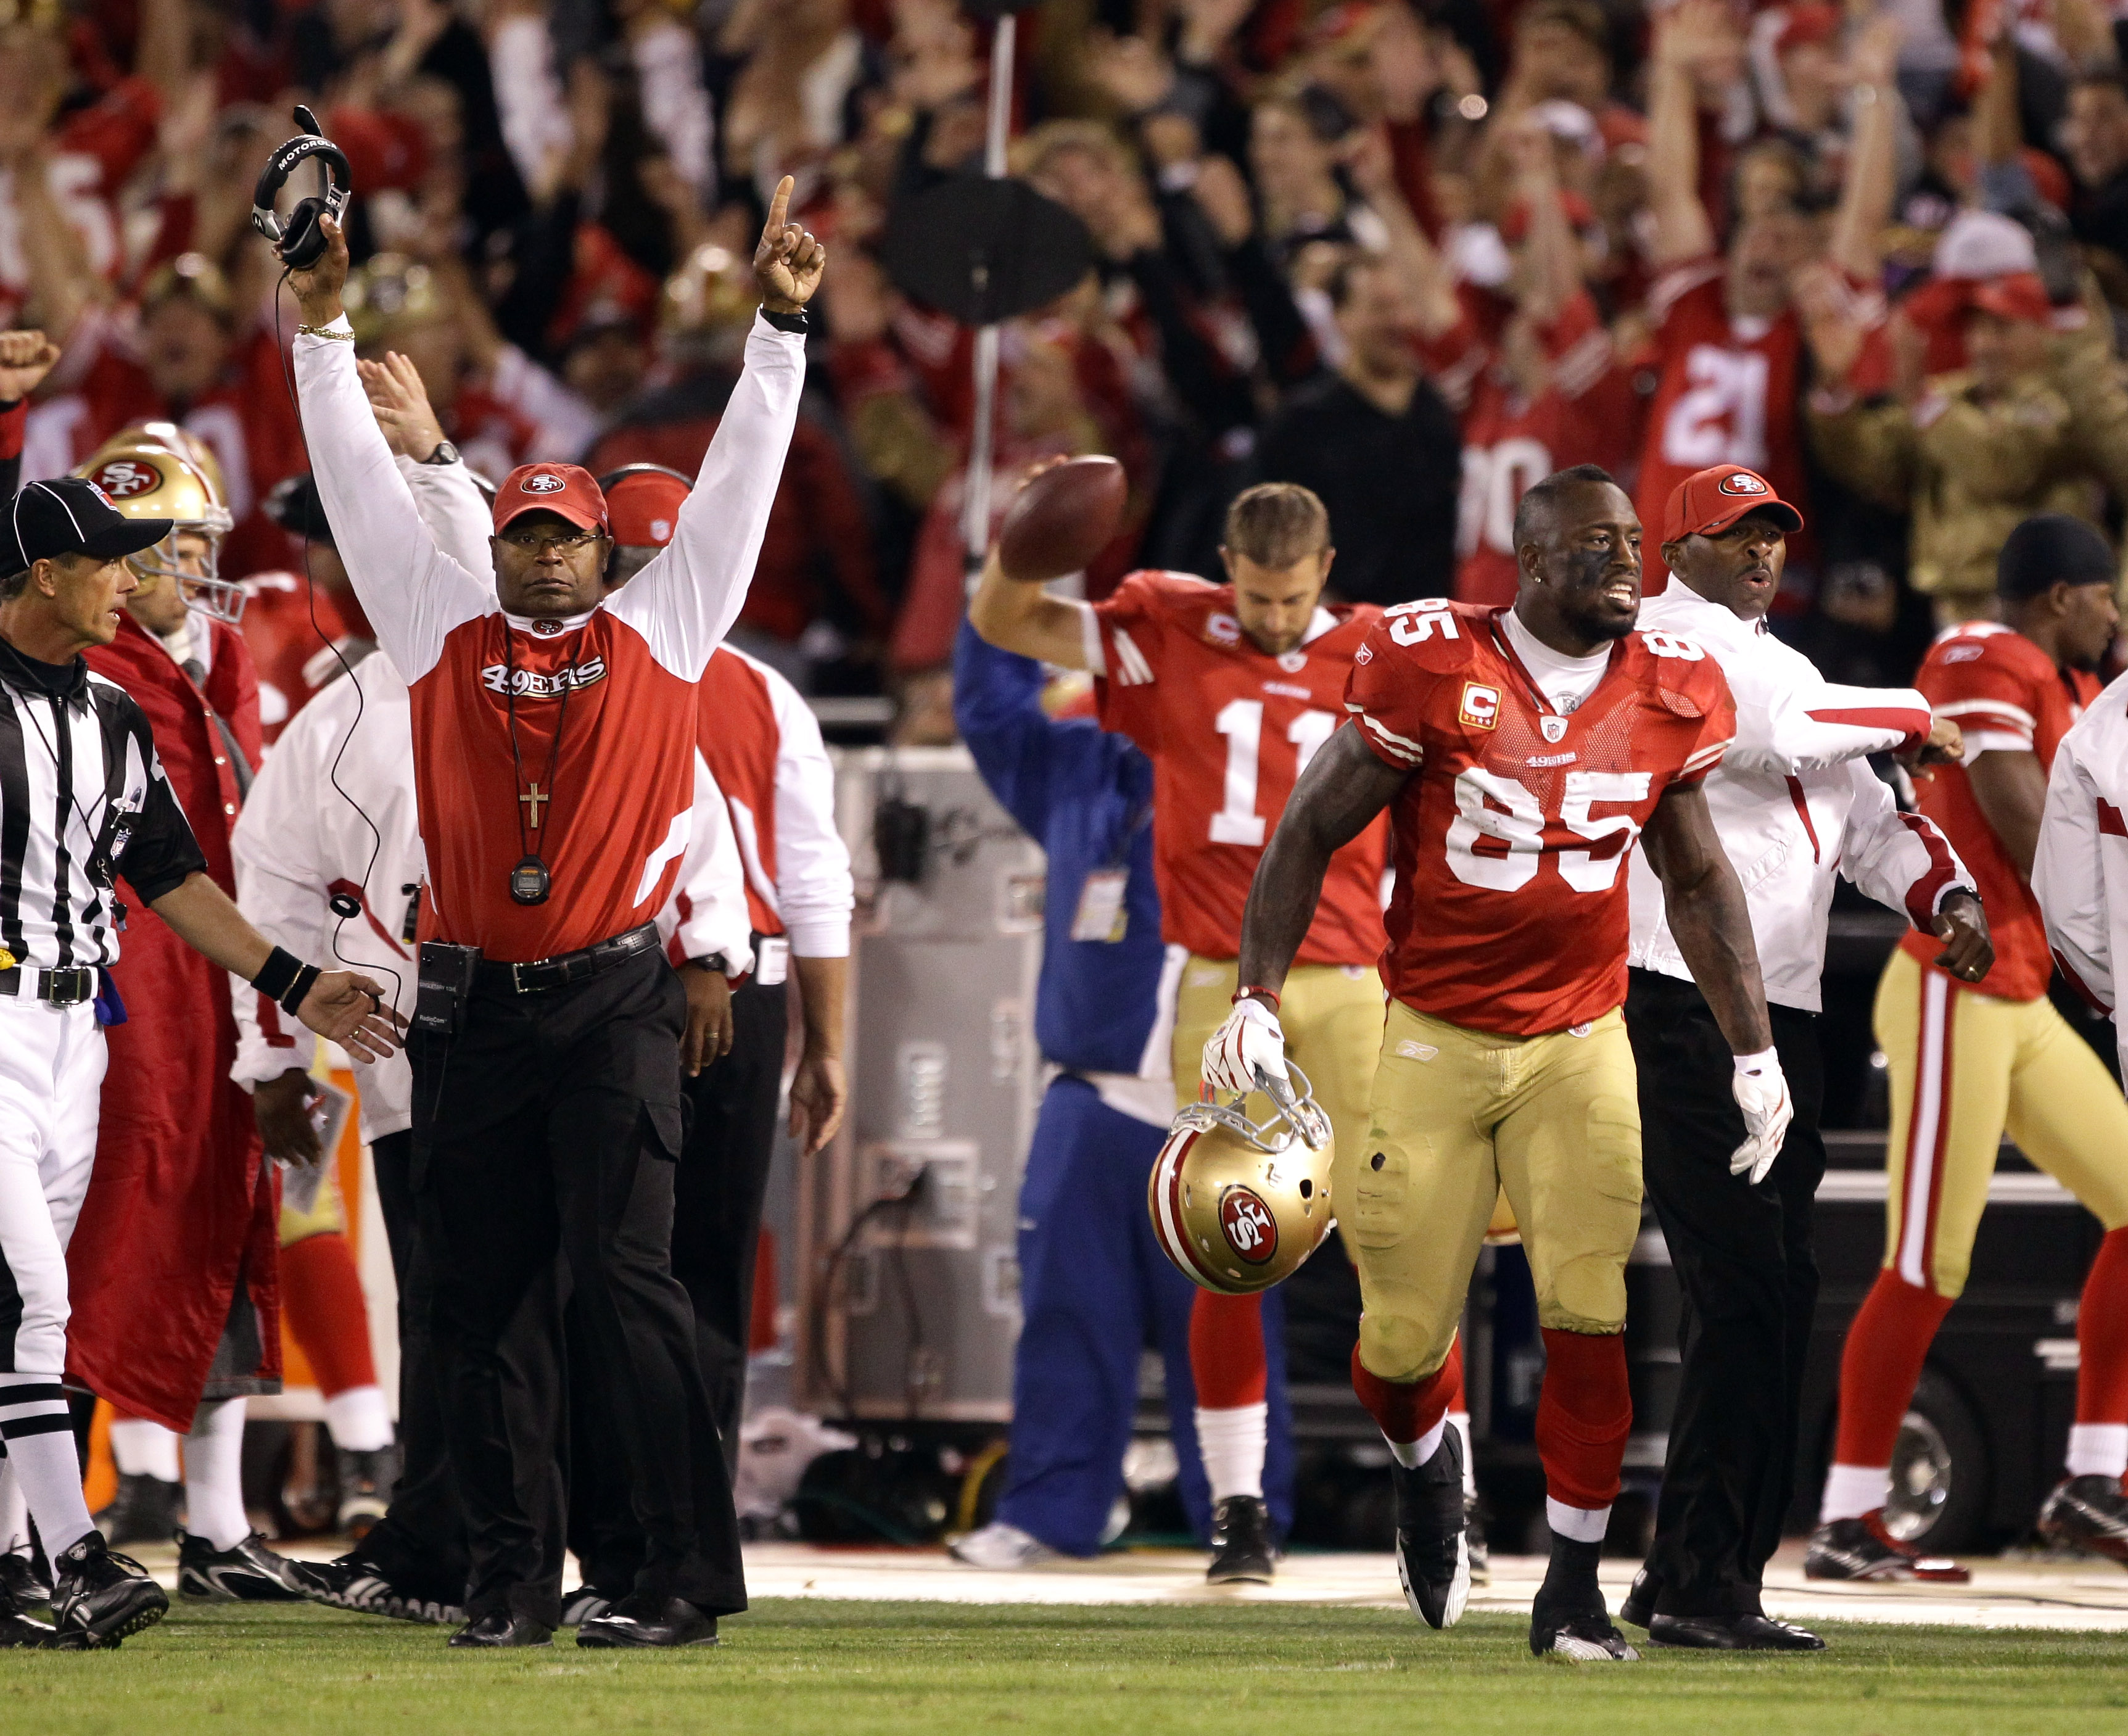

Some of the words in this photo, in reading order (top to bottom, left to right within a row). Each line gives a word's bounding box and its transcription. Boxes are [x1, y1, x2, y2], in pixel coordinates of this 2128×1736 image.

[278, 140, 337, 170] MOTOROLA
[1663, 345, 1769, 469] 21
[1383, 597, 1460, 647] 85
[1634, 626, 1706, 662] 8
[481, 655, 608, 698] 49ERS
[1464, 686, 1498, 718] C
[1445, 767, 1653, 893] 85
